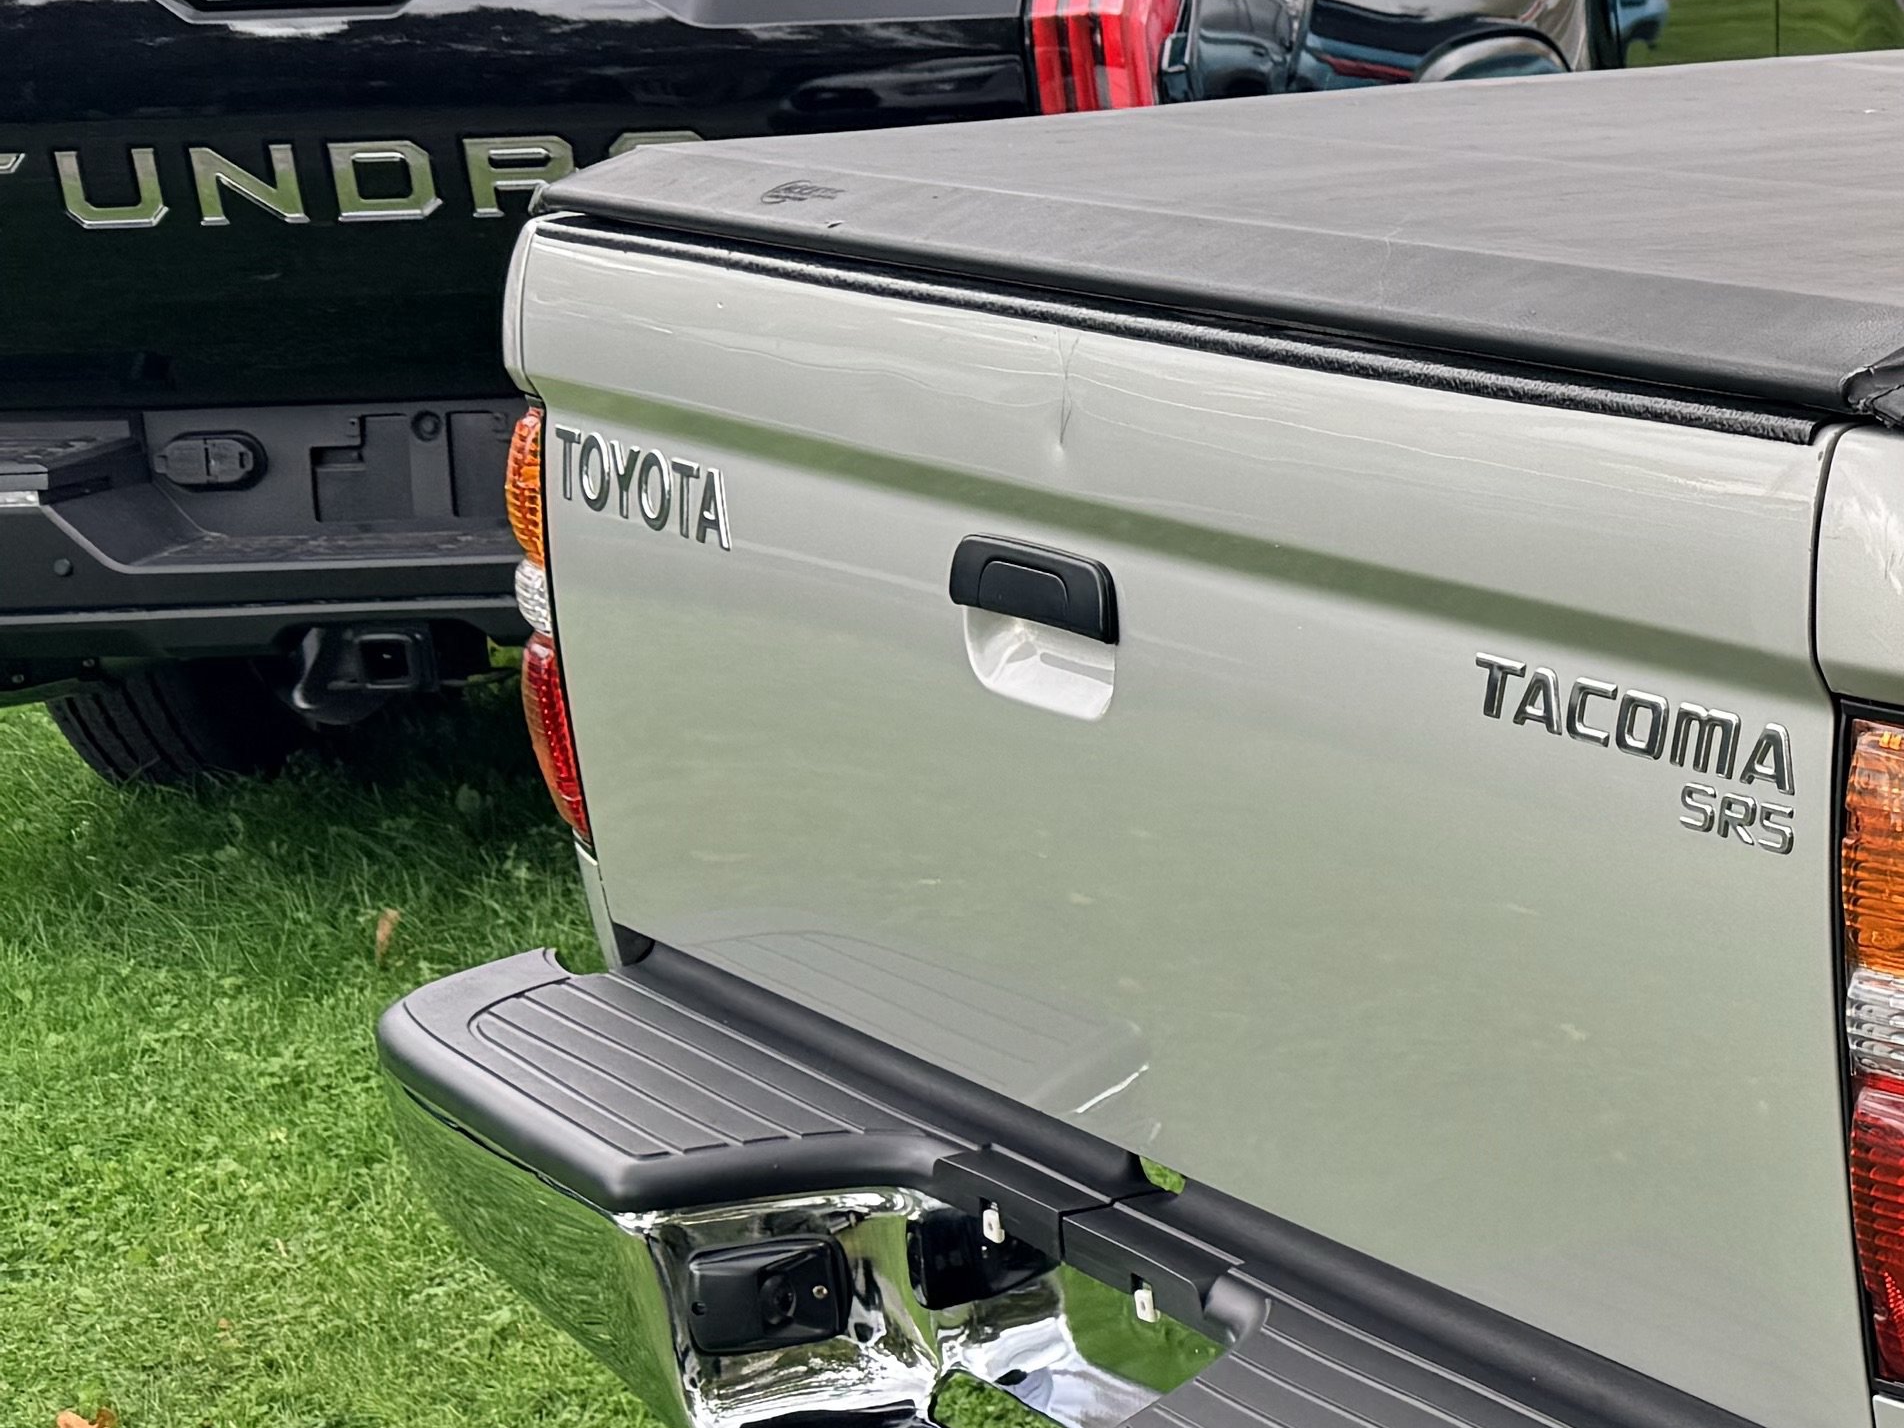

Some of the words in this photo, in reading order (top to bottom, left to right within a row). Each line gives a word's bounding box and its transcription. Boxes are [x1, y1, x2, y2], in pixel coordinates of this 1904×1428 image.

[555, 424, 733, 551] TOYOTA
[1475, 652, 1796, 796] TACOMA
[1679, 782, 1796, 855] SR5
